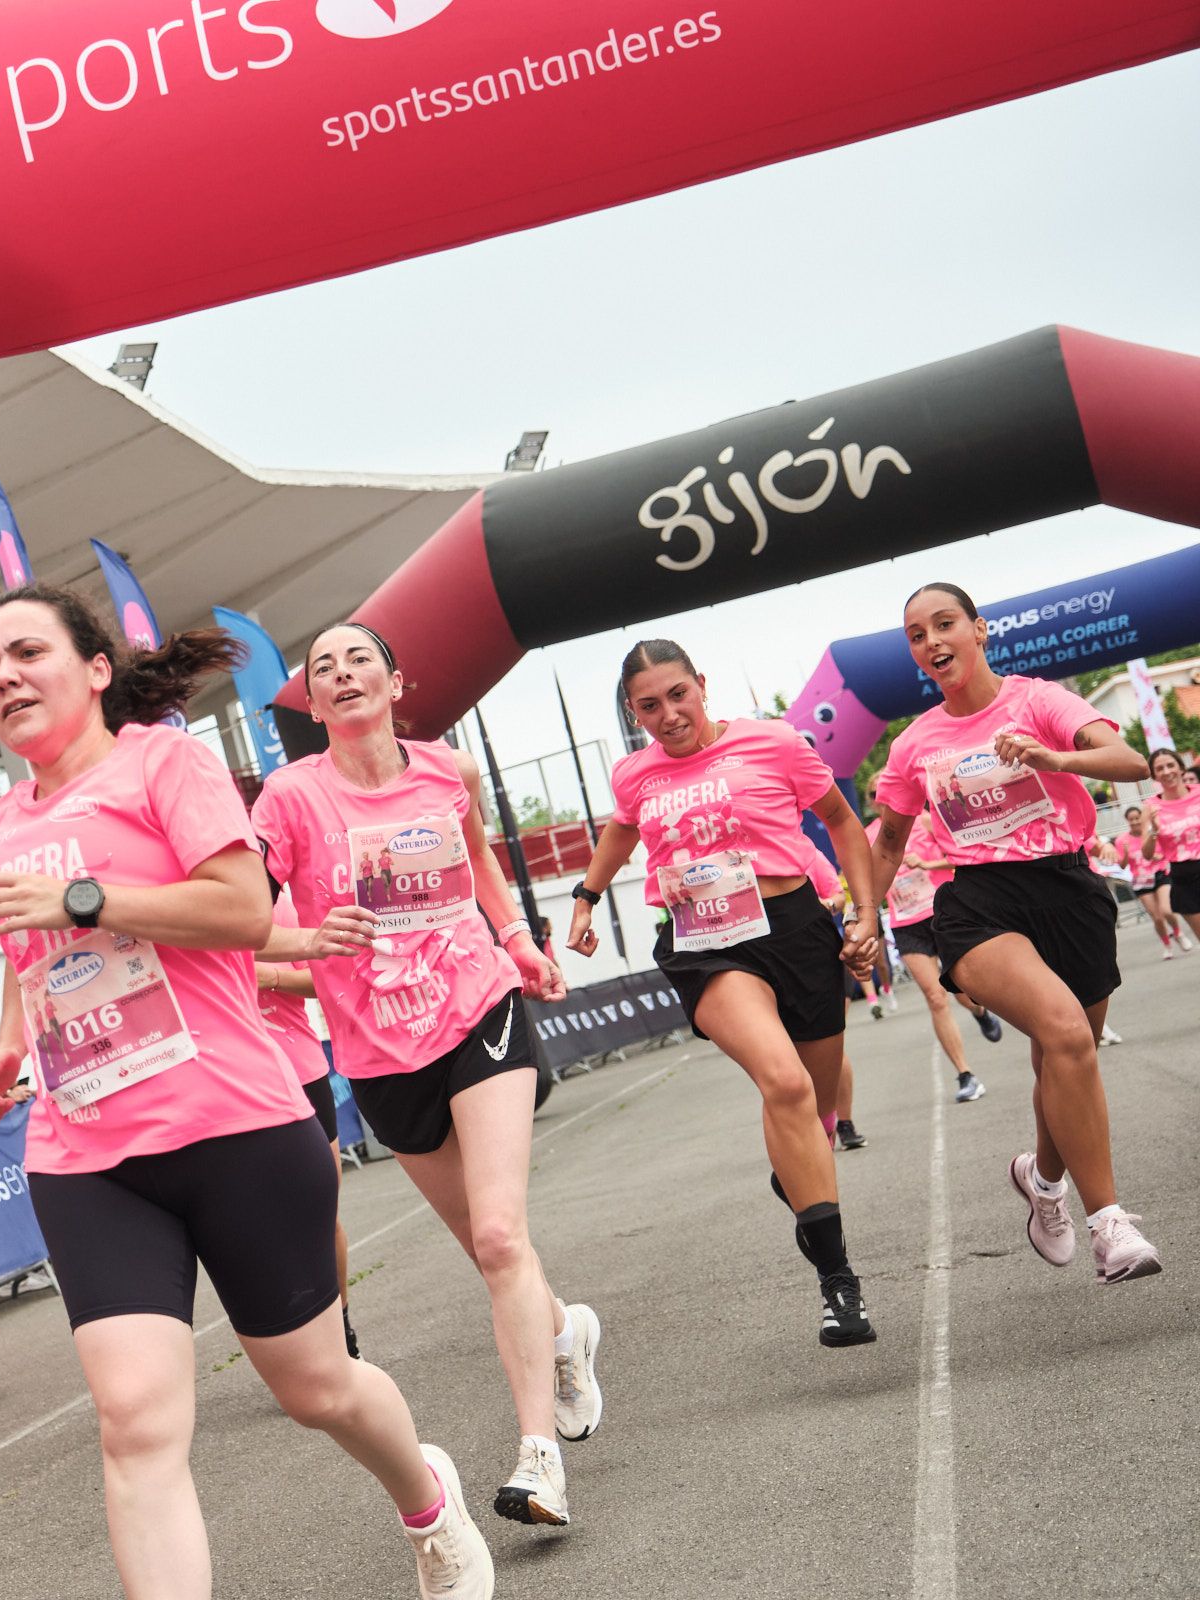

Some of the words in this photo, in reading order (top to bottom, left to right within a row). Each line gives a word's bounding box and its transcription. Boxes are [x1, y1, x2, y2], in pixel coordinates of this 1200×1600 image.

[321, 10, 723, 151] sportssantander.es
[638, 417, 912, 571] gijón
[1014, 633, 1059, 656] PARA
[1062, 614, 1129, 644] CORRER
[1055, 646, 1077, 663] DE
[1080, 641, 1102, 656] LA
[1106, 630, 1138, 650] LUZ
[959, 760, 995, 775] ASTURIANA
[640, 777, 732, 825] CARRERA
[968, 787, 1007, 808] 016
[392, 838, 439, 850] ASTURIANA
[962, 827, 992, 841] OYSHO
[395, 870, 443, 892] 016
[375, 905, 403, 915] CARRERA
[404, 904, 412, 912] DE
[411, 893, 430, 902] 988
[696, 897, 730, 917] 016
[373, 916, 411, 929] OYSHO
[685, 938, 711, 948] OYSHO
[50, 960, 100, 990] ASTURIANA
[374, 970, 451, 1030] MUJER
[65, 1002, 124, 1046] 016
[407, 1015, 439, 1039] 2026
[566, 999, 635, 1032] VOLVO
[91, 1038, 113, 1055] 336
[59, 1064, 88, 1084] CARRERA
[87, 1059, 98, 1071] DE
[97, 1054, 109, 1066] LA
[108, 1043, 135, 1062] MUJER
[64, 1078, 101, 1102] OYSHO
[129, 1047, 176, 1074] Santander
